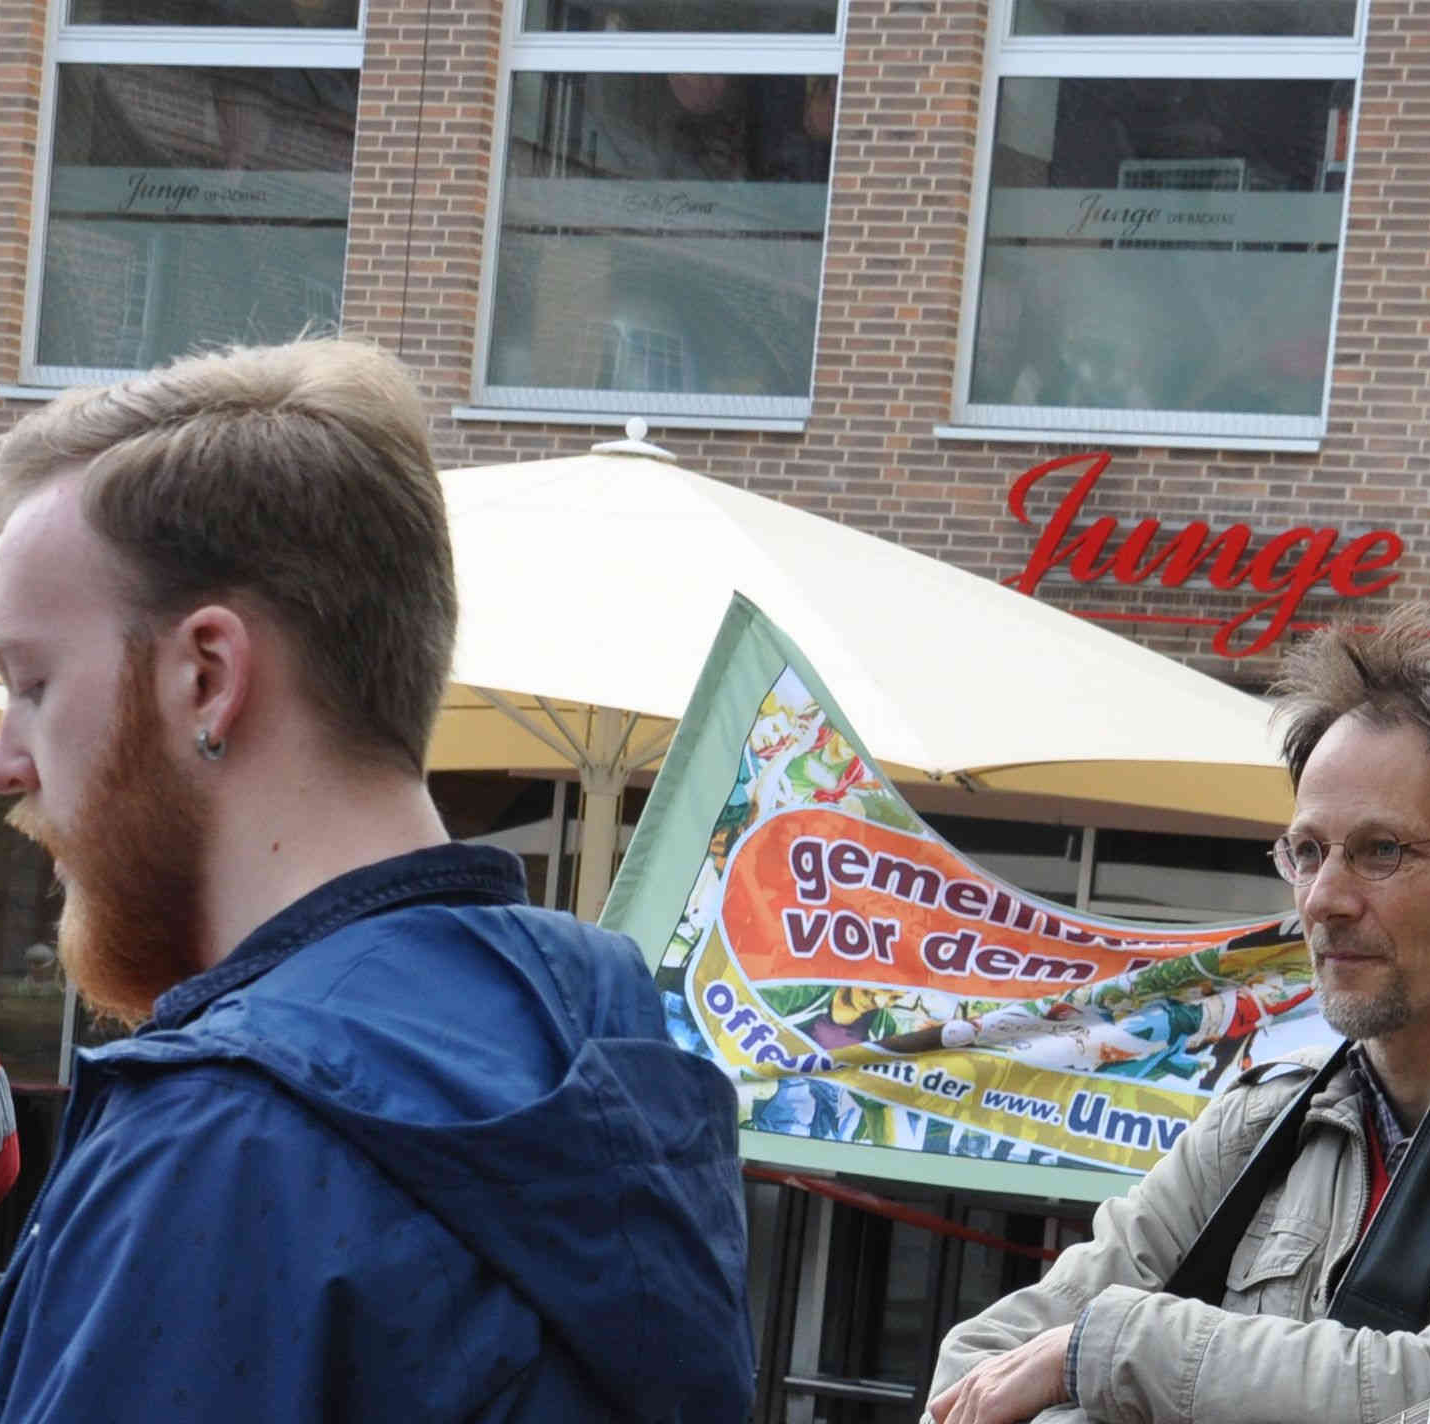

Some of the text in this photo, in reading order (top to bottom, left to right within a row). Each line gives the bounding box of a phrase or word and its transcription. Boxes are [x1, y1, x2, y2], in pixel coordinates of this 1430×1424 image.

[117, 172, 200, 213] Junge
[1067, 192, 1161, 236] Junge
[1001, 452, 1404, 659] Junge
[785, 911, 1097, 980] vor dem
[922, 1067, 972, 1098] der
